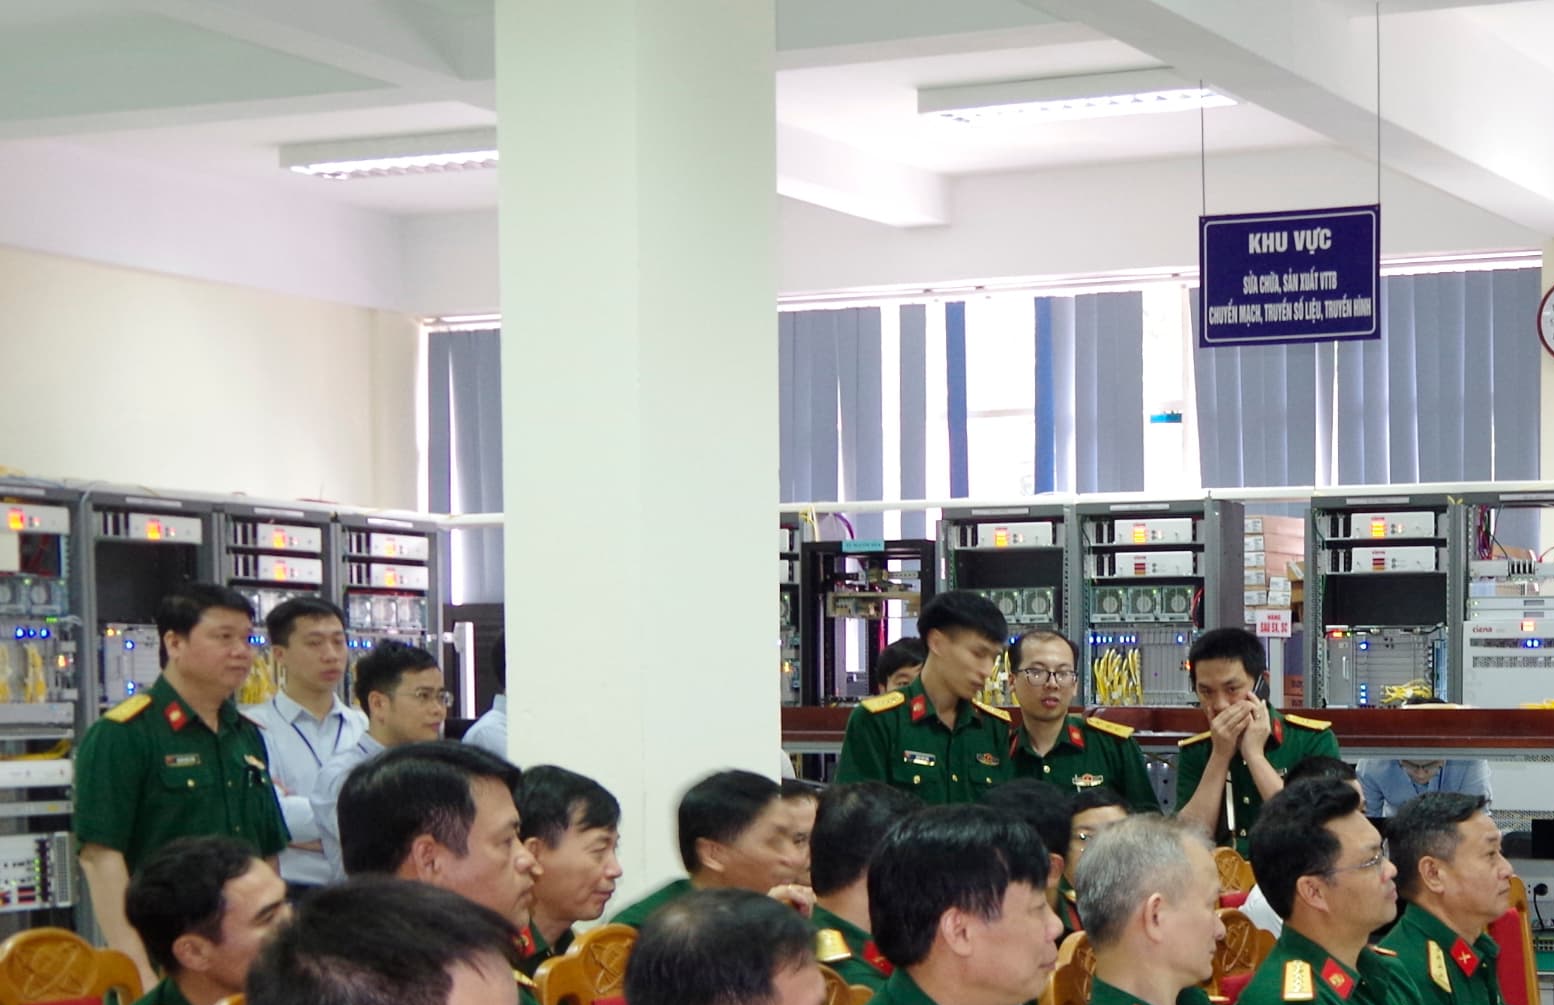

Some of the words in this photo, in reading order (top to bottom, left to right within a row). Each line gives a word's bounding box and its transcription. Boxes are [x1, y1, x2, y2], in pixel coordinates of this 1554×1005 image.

[1249, 231, 1288, 254] KHU
[1293, 227, 1332, 255] VỰC
[1283, 267, 1298, 293] SẢN
[1319, 271, 1338, 290] VTTB
